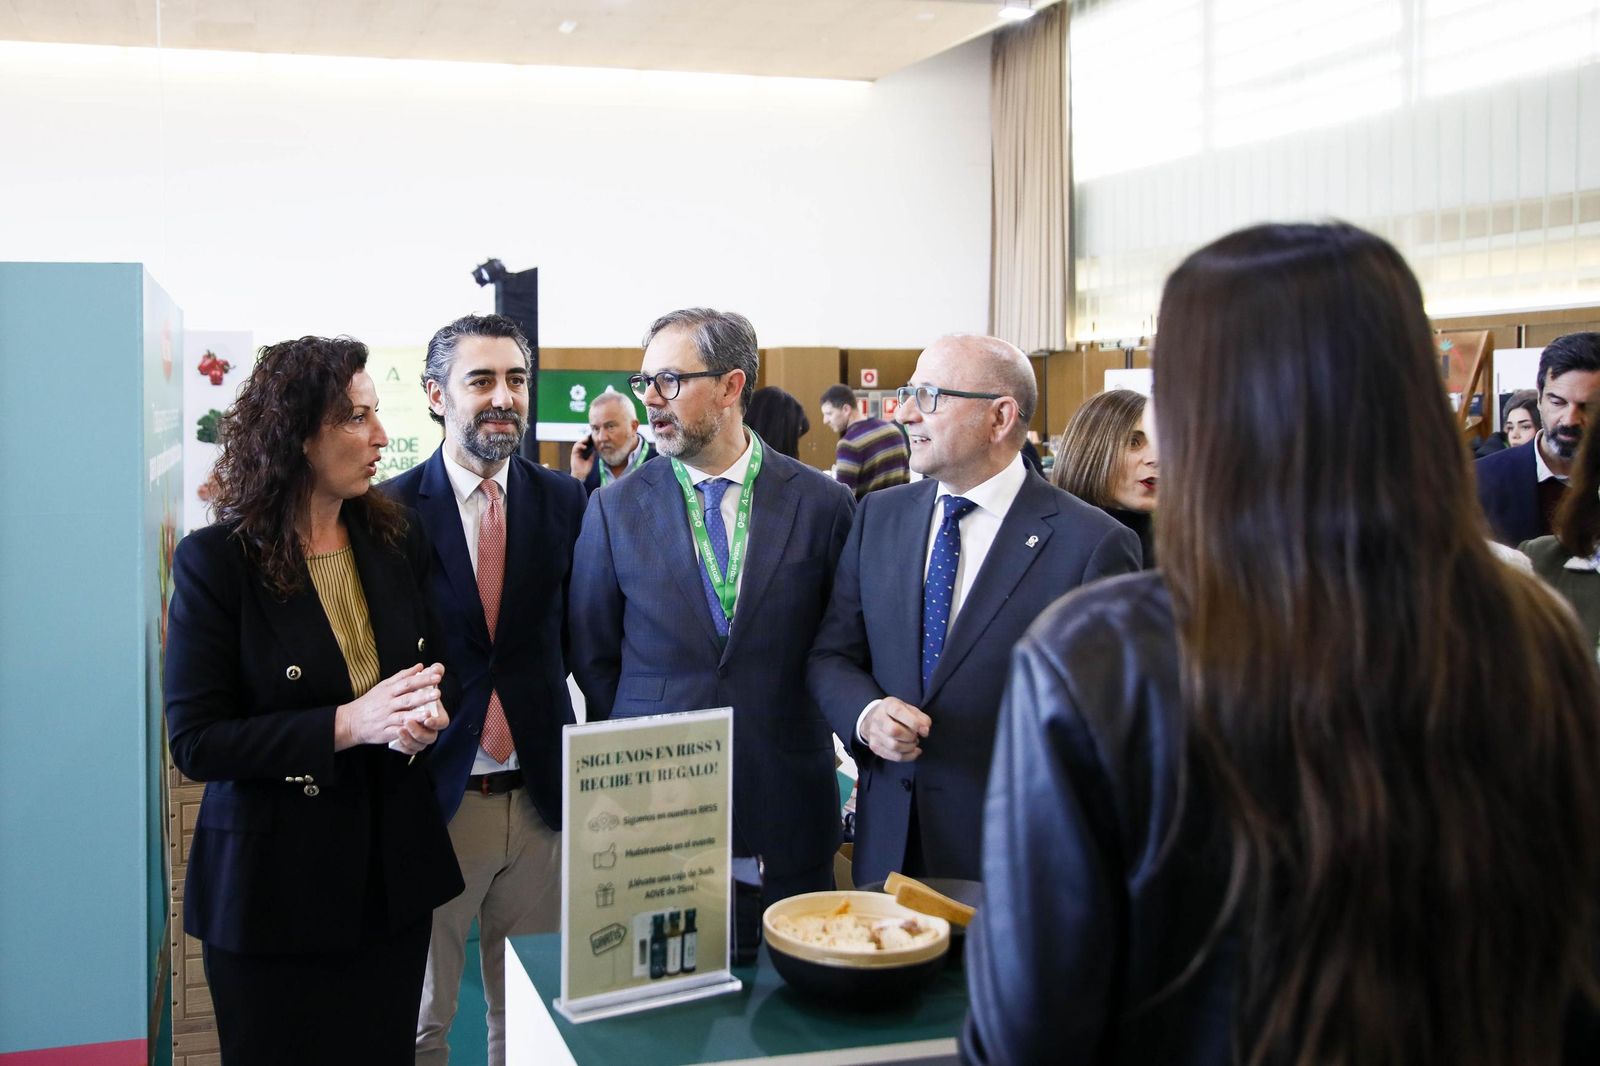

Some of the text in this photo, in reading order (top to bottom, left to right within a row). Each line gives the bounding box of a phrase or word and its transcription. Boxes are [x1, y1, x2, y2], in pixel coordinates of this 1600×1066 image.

[381, 437, 419, 453] RDE
[656, 745, 674, 759] EN
[677, 740, 712, 757] RRSS
[713, 739, 722, 752] Y
[580, 761, 718, 792] RECIBE TU REGALO!
